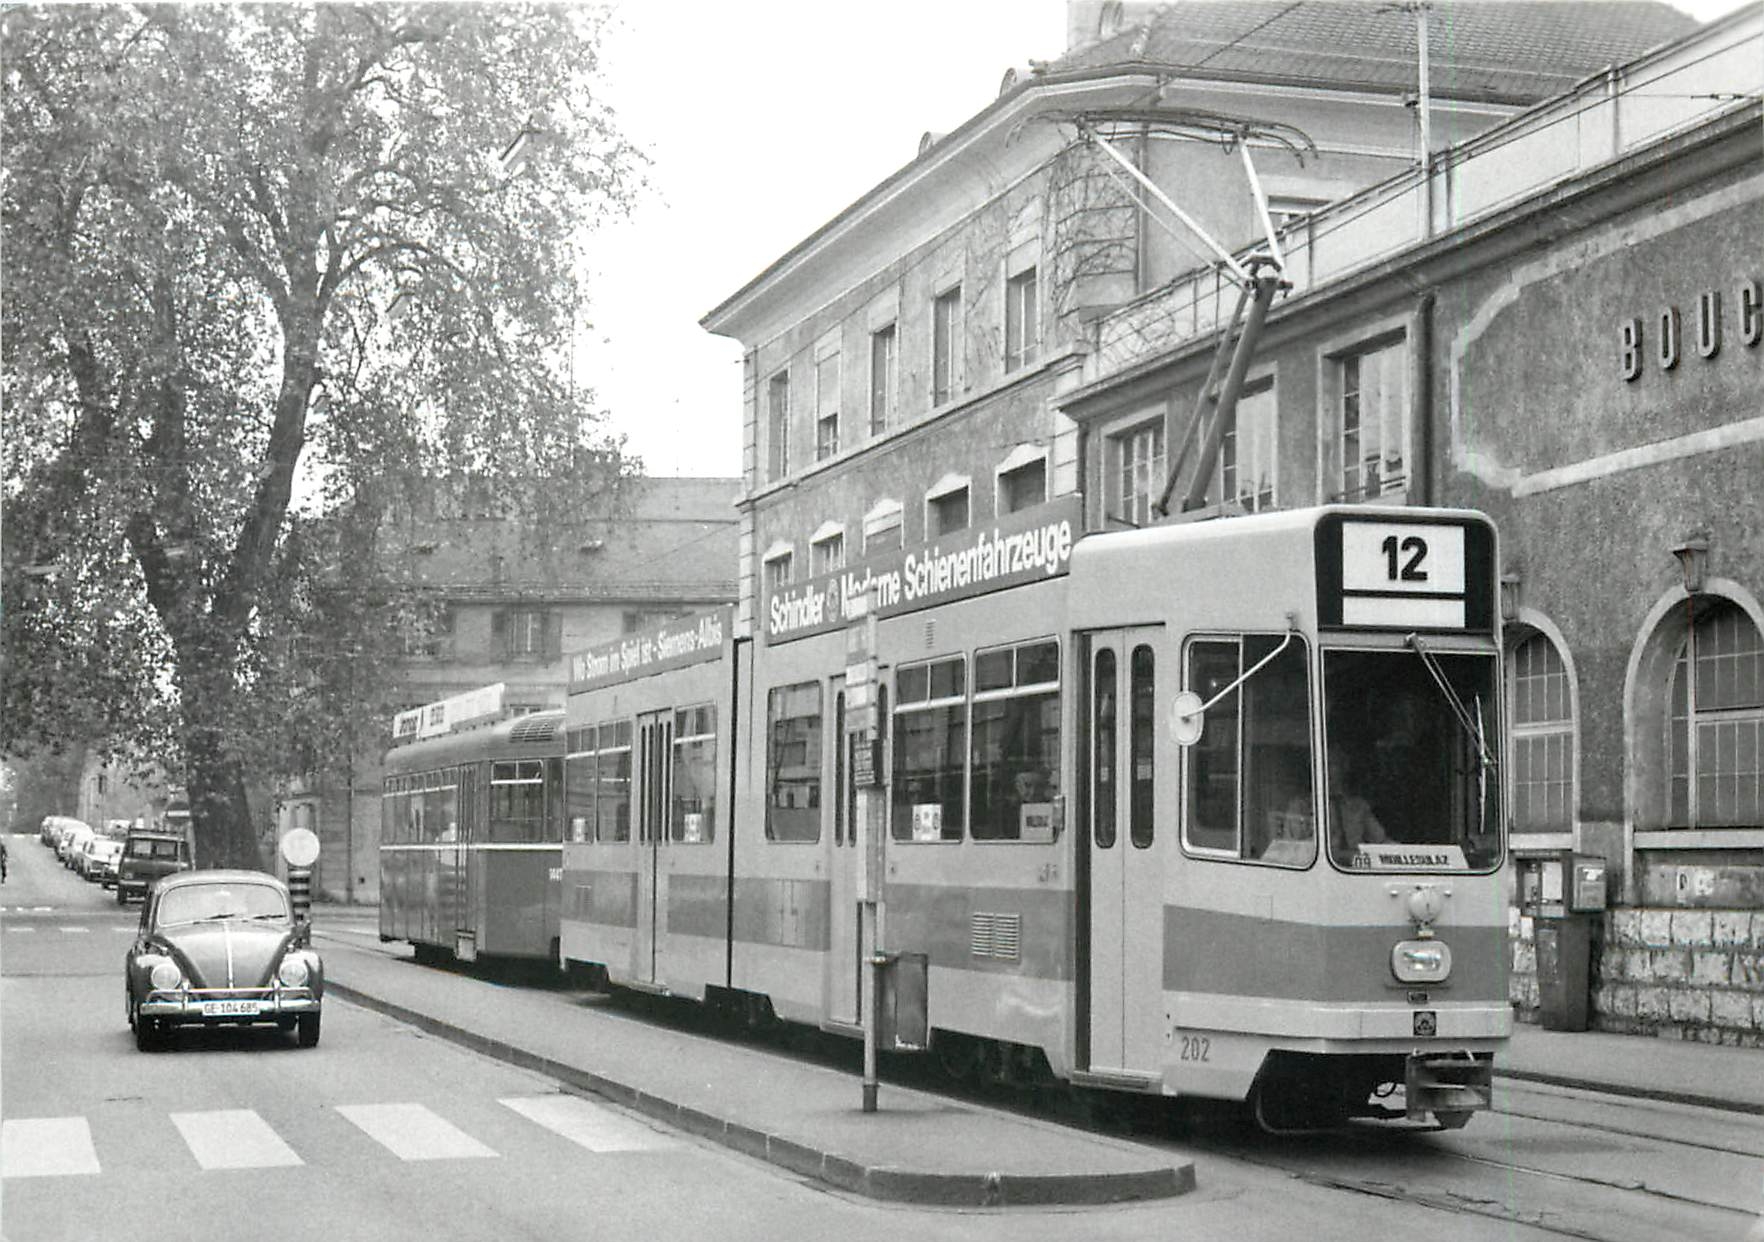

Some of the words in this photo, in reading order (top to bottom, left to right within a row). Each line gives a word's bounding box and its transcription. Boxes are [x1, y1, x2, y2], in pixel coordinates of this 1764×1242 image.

[1618, 279, 1763, 383] BOUC
[770, 584, 825, 635] Schindler
[904, 520, 1071, 600] Schienenfahrzeuge
[1382, 535, 1428, 581] 12
[1180, 1036, 1210, 1062] 202
